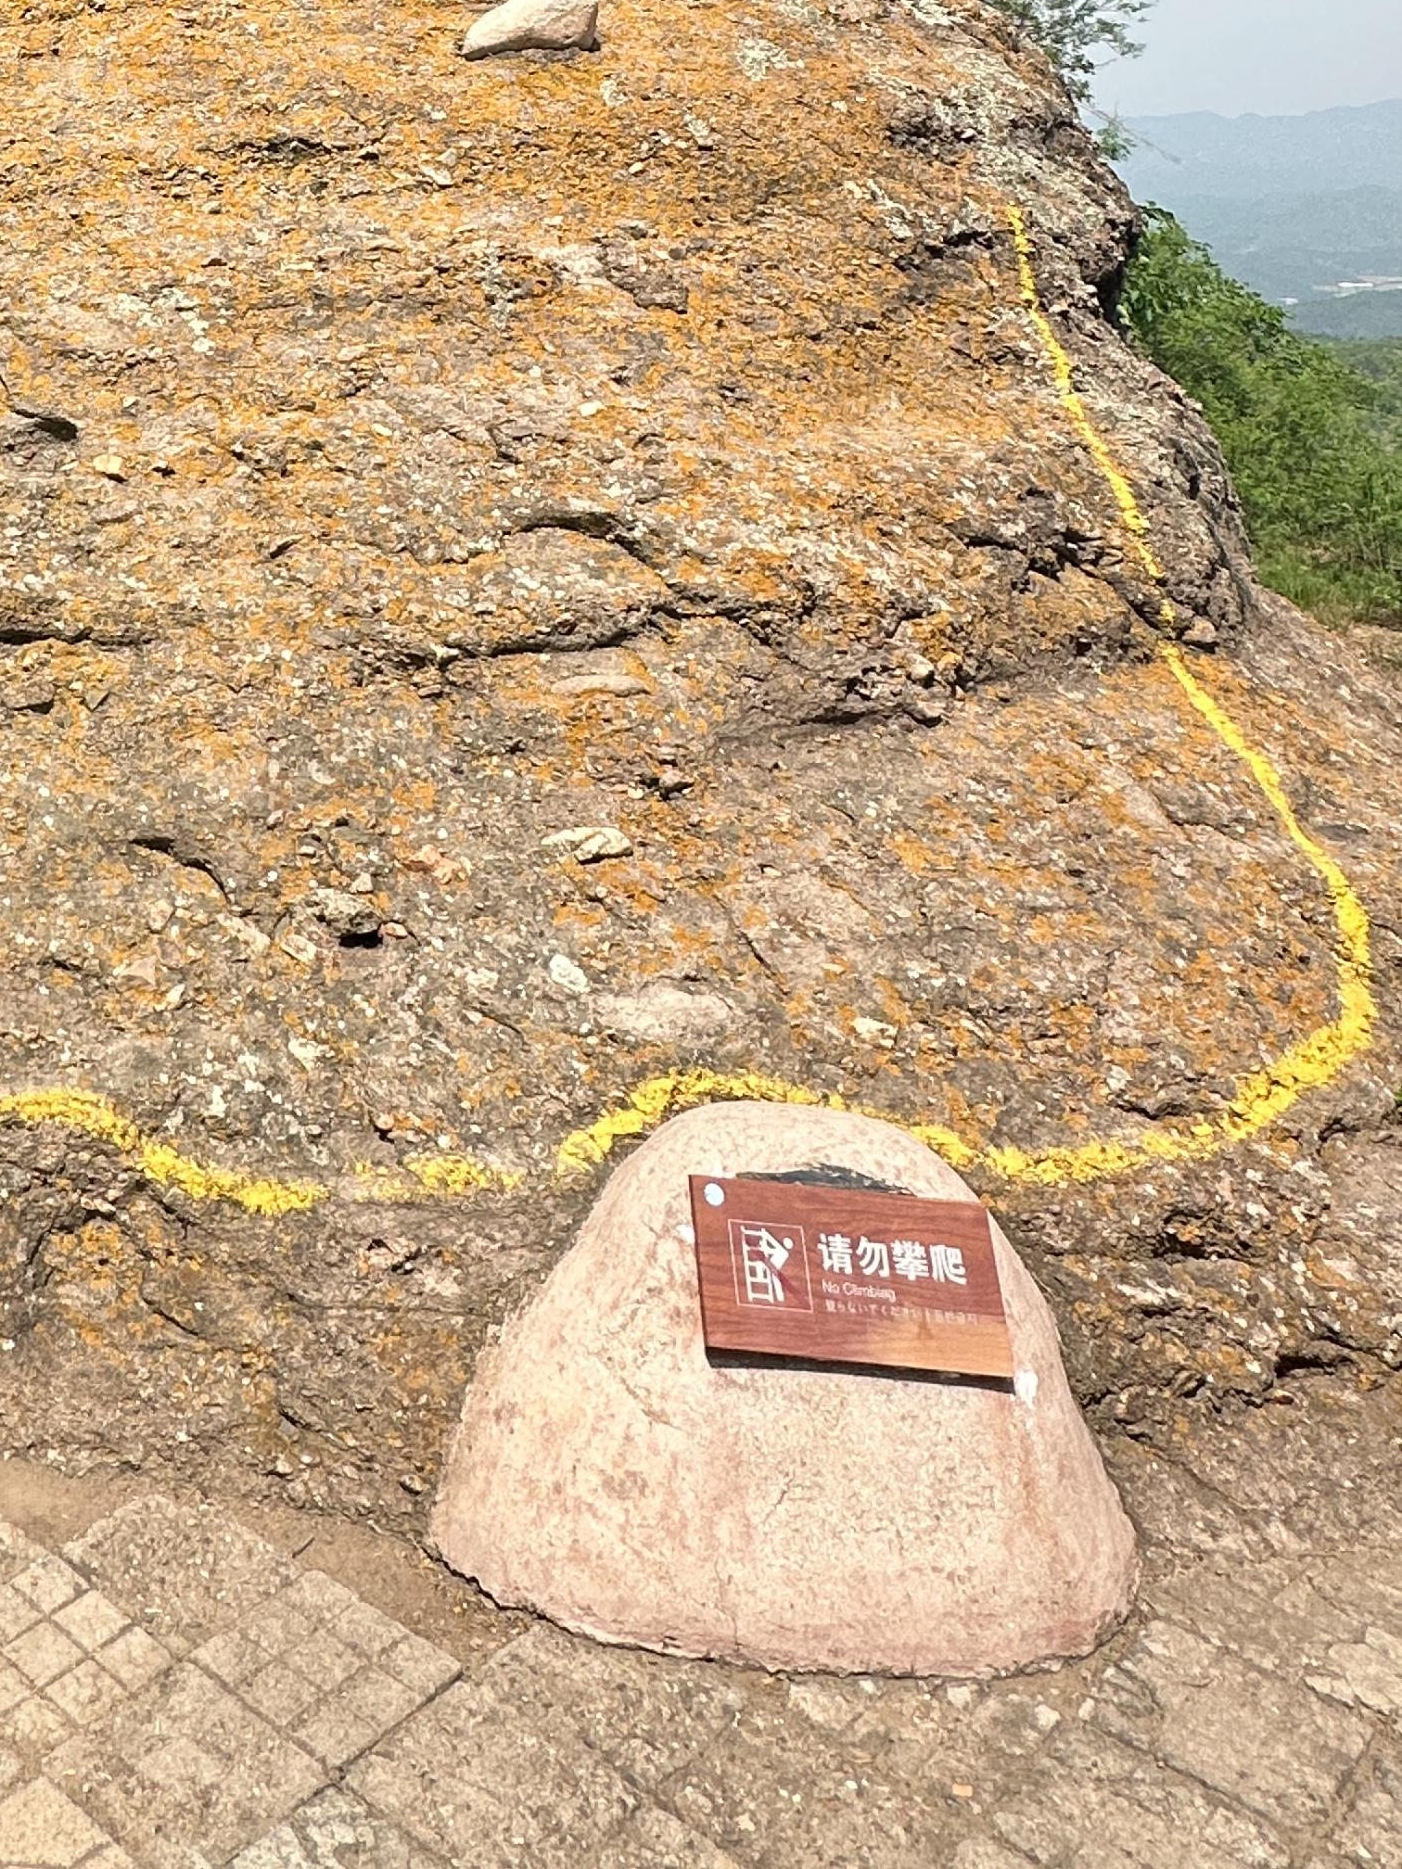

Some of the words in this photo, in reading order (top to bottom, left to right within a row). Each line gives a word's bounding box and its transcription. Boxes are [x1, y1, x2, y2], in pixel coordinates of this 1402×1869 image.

[817, 1233, 967, 1285] 请勿攀爬
[821, 1279, 840, 1294] No
